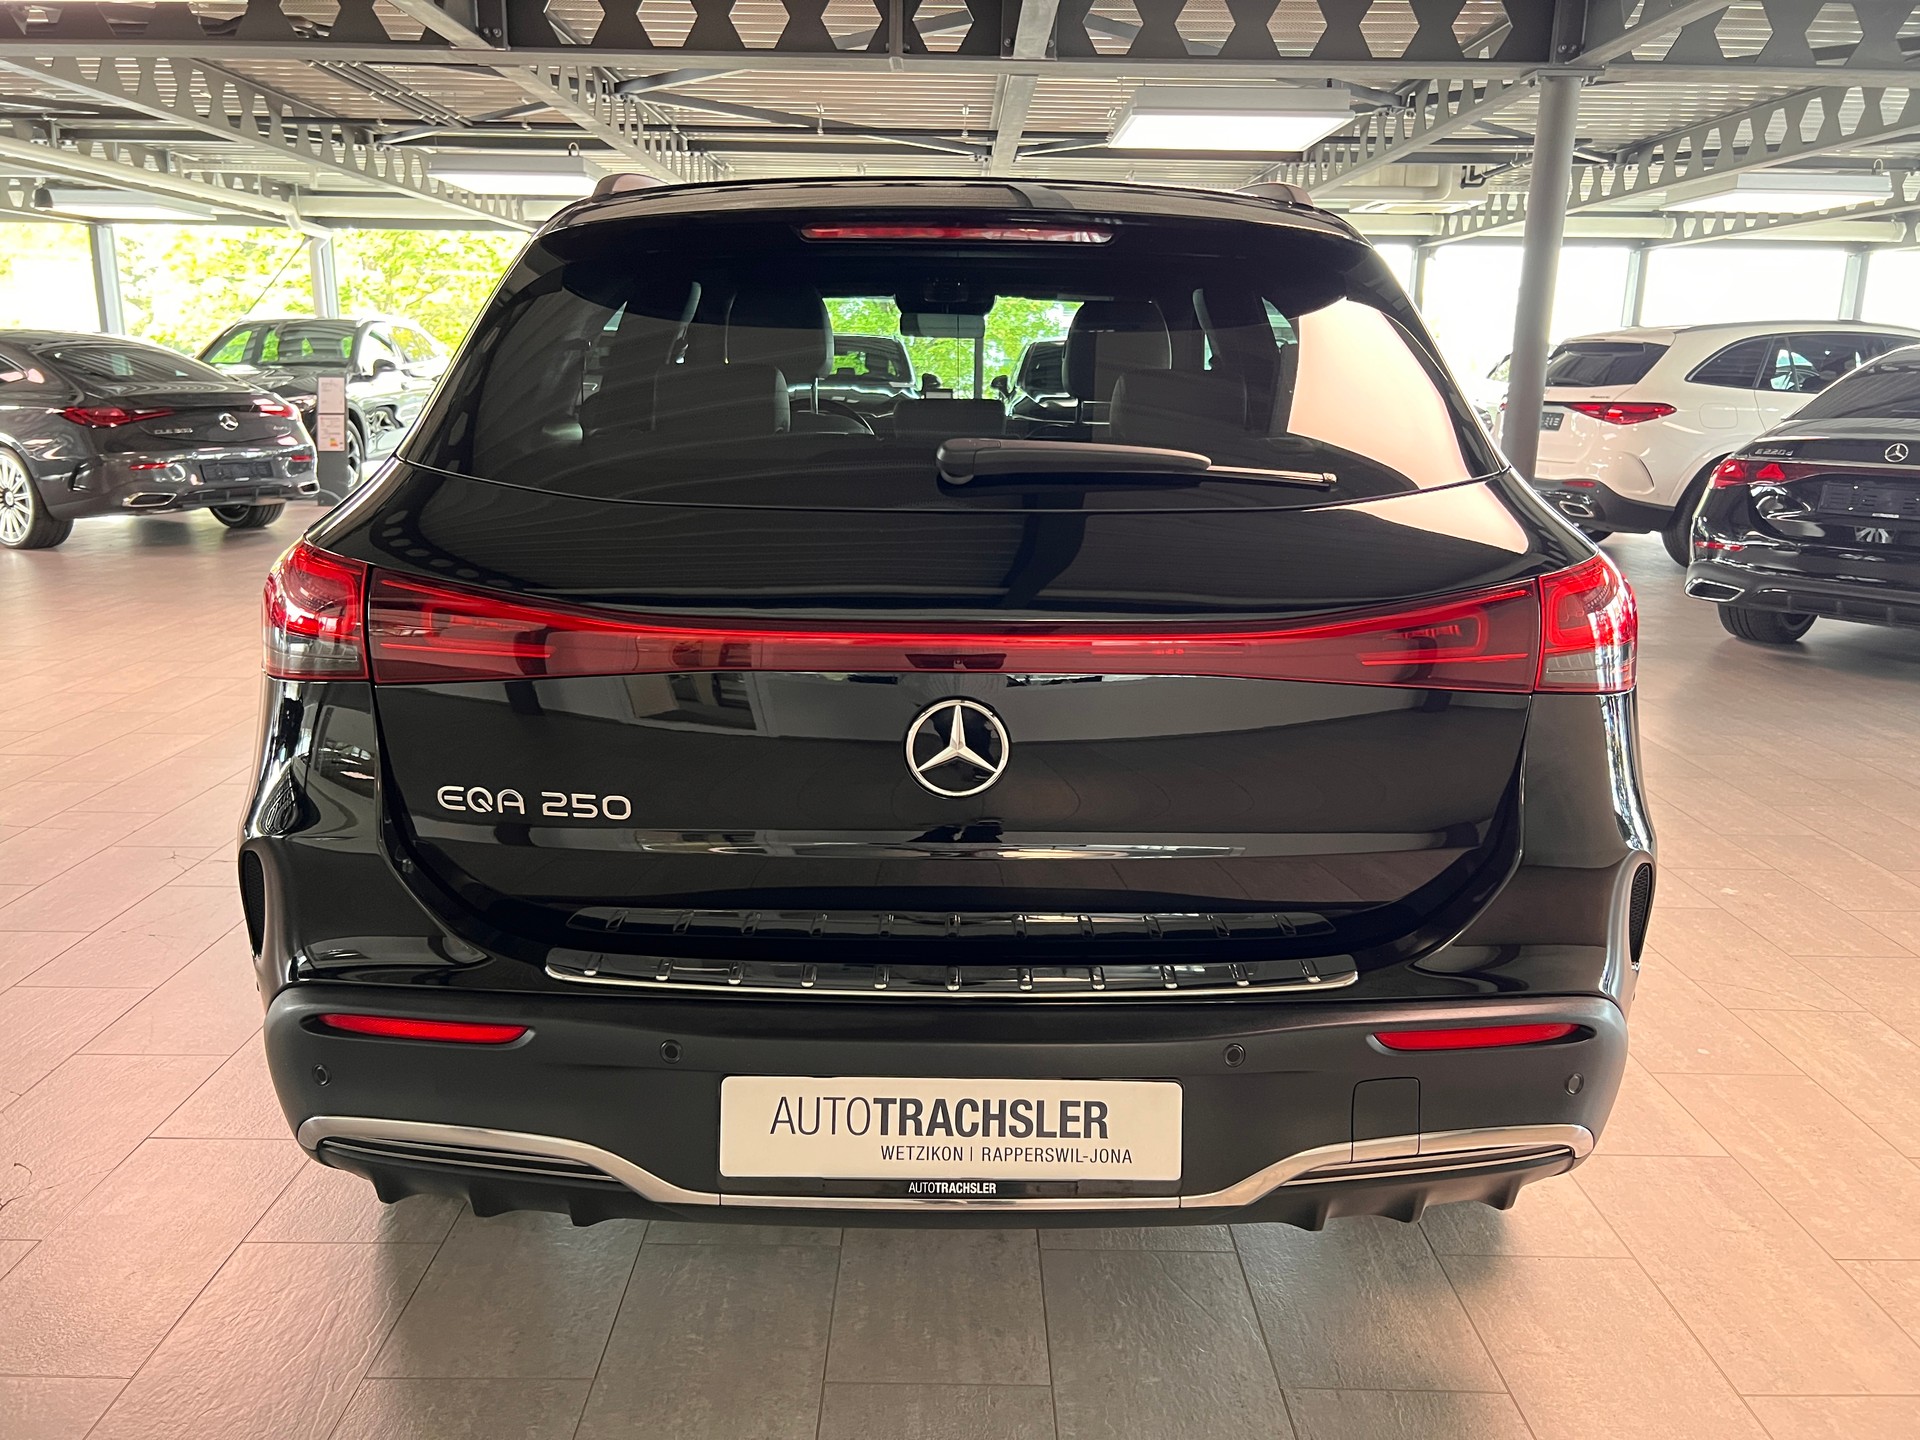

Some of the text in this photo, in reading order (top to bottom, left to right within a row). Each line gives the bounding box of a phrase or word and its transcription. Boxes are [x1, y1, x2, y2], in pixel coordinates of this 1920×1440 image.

[437, 785, 632, 820] EQA 250
[770, 1096, 1109, 1139] AUTOTRACHSLER
[880, 1145, 963, 1161] WETZIKON
[981, 1147, 1133, 1164] RAPPERSWIL-JONA
[908, 1181, 997, 1194] AUTOTRACHSLER
